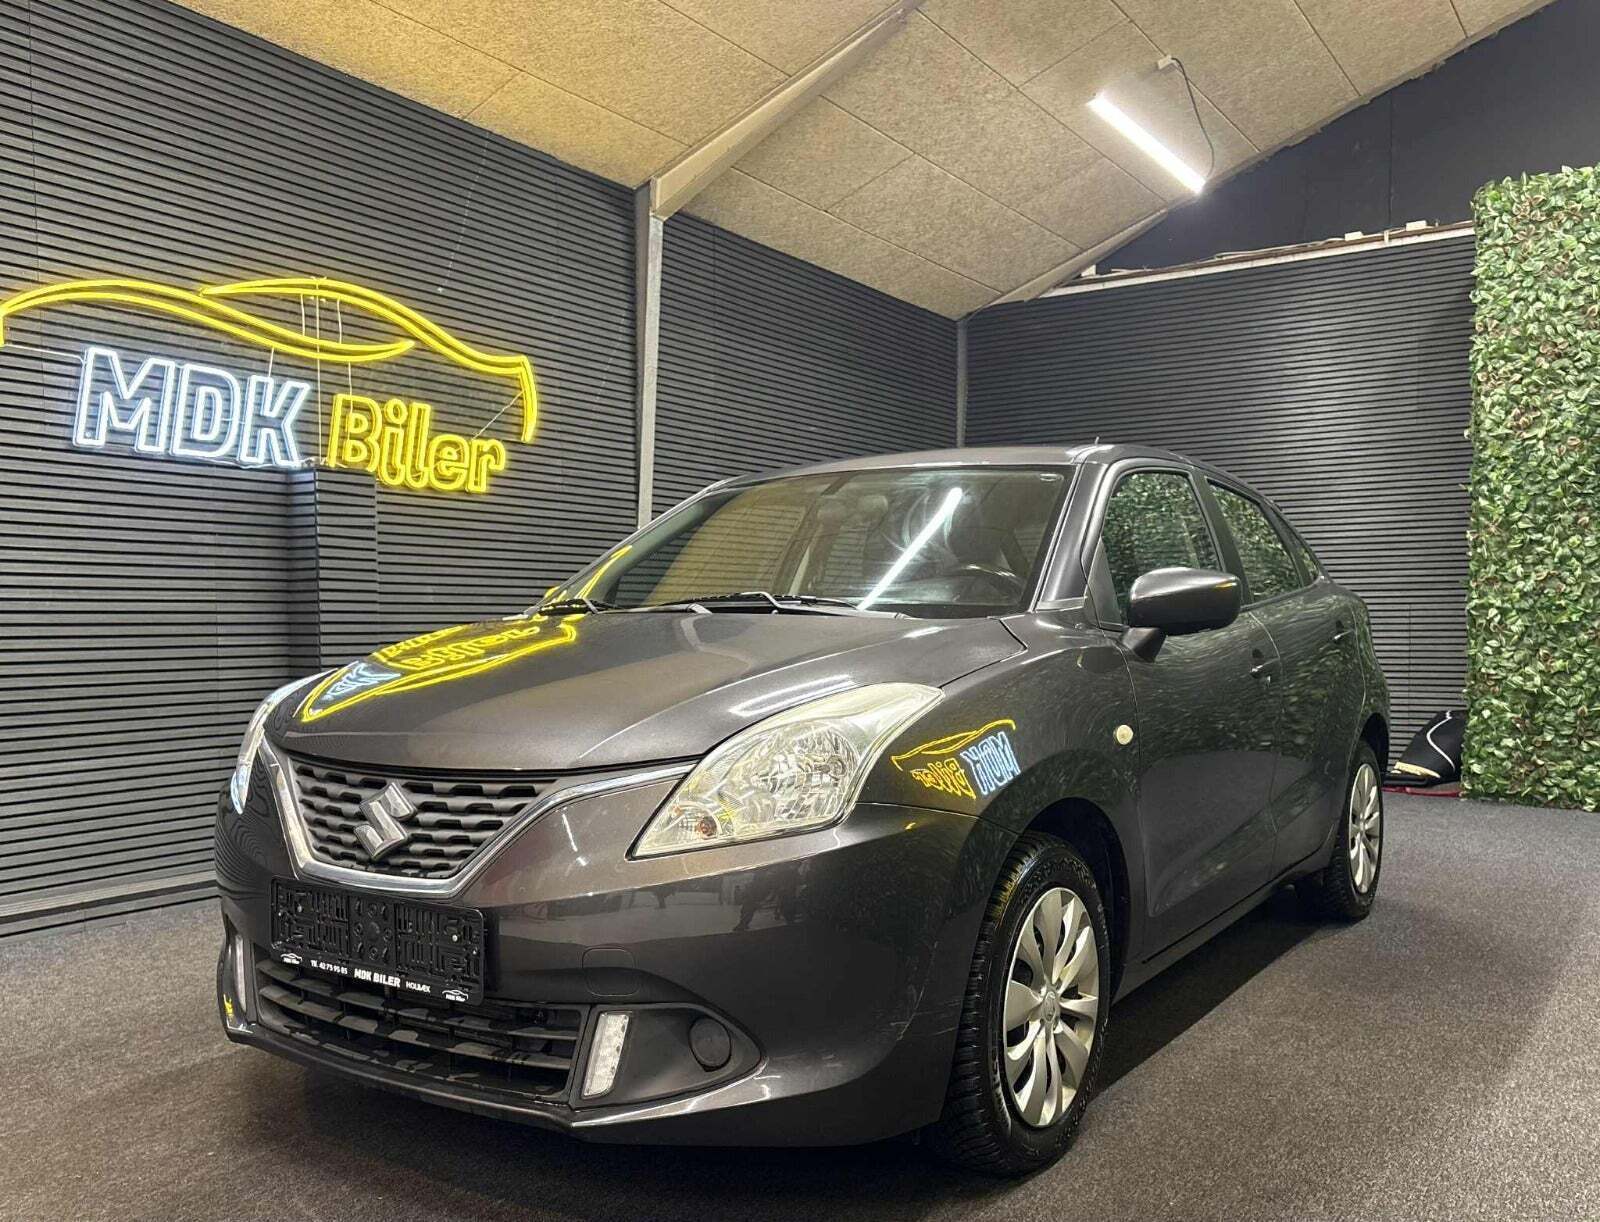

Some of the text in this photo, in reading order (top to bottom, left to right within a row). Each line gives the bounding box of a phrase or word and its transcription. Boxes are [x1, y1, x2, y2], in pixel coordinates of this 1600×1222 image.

[72, 346, 507, 494] MDK Biler
[354, 968, 400, 988] MDK BILER
